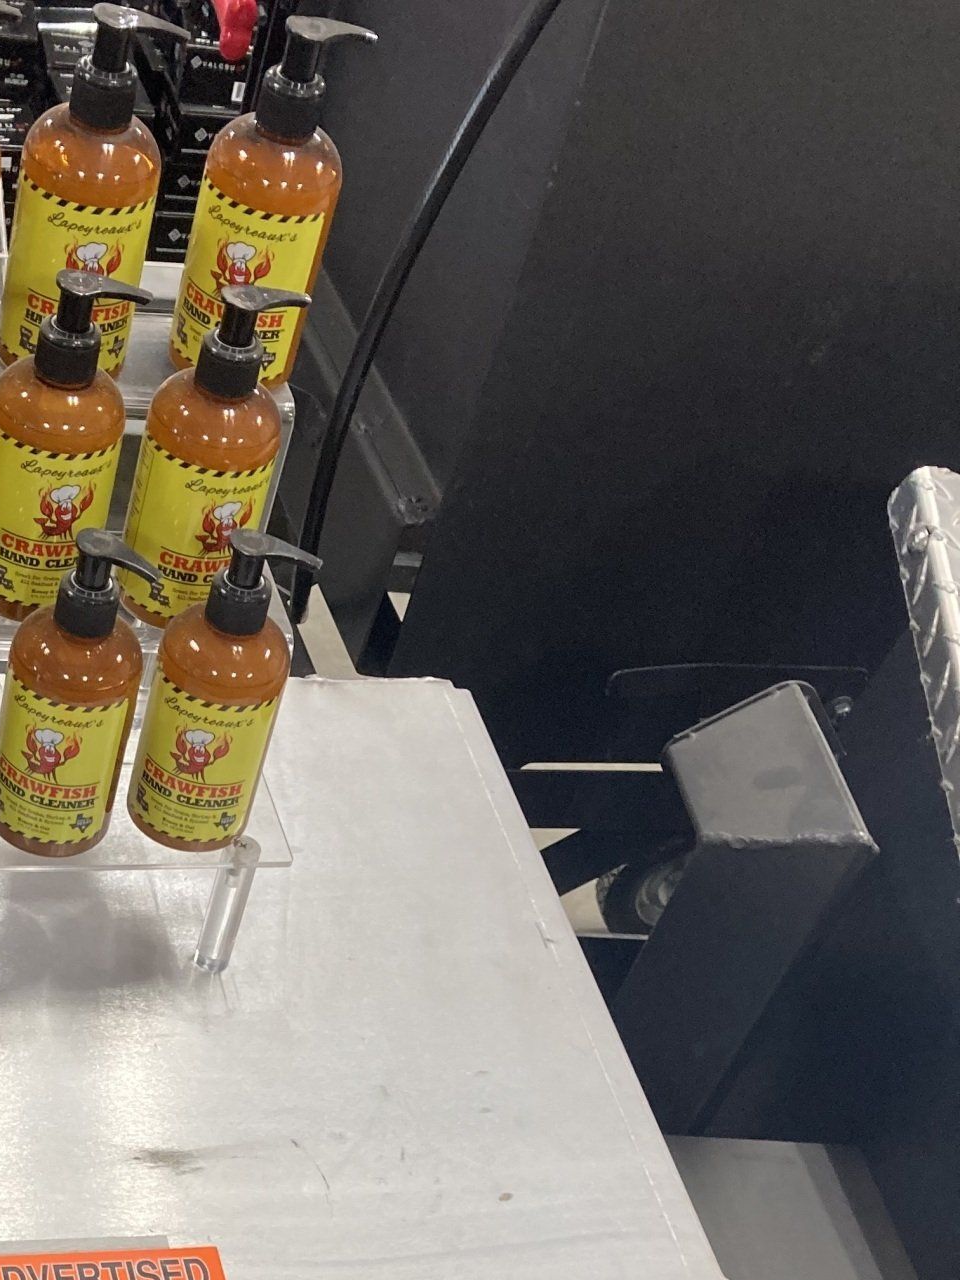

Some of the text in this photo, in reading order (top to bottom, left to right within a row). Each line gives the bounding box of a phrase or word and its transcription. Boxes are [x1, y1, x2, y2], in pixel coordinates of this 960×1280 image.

[184, 298, 211, 326] HAND
[0, 546, 40, 567] HAND
[0, 757, 98, 799] CRAWFISH
[142, 771, 239, 808] HAND CLEANER
[144, 758, 243, 798] CRAWFISH
[30, 795, 95, 809] CLEANER
